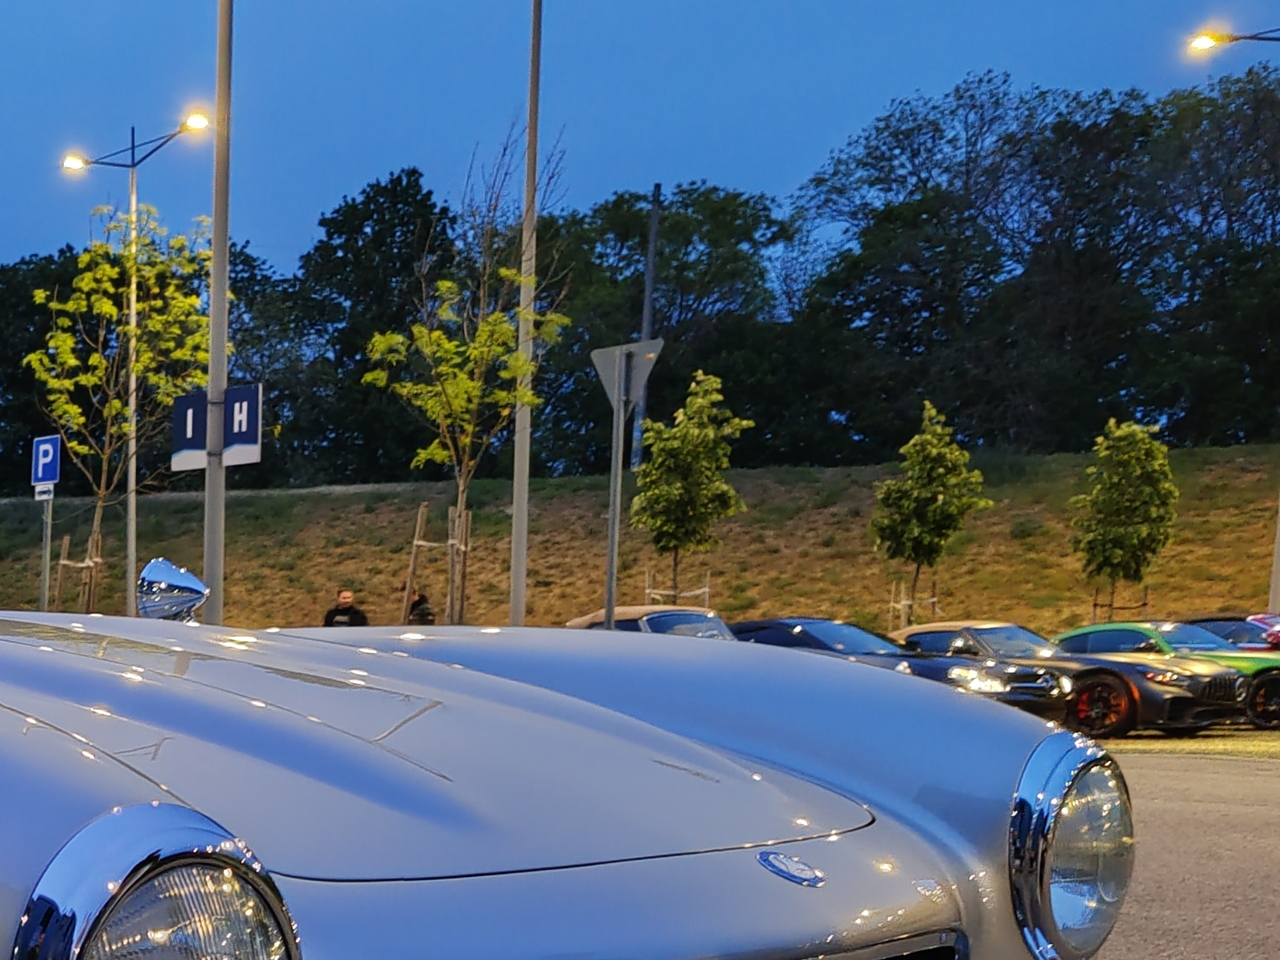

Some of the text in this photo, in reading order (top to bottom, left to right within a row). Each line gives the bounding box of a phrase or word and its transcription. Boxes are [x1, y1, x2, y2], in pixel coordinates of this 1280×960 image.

[186, 408, 194, 439] I
[233, 401, 248, 433] H
[37, 443, 54, 478] P
